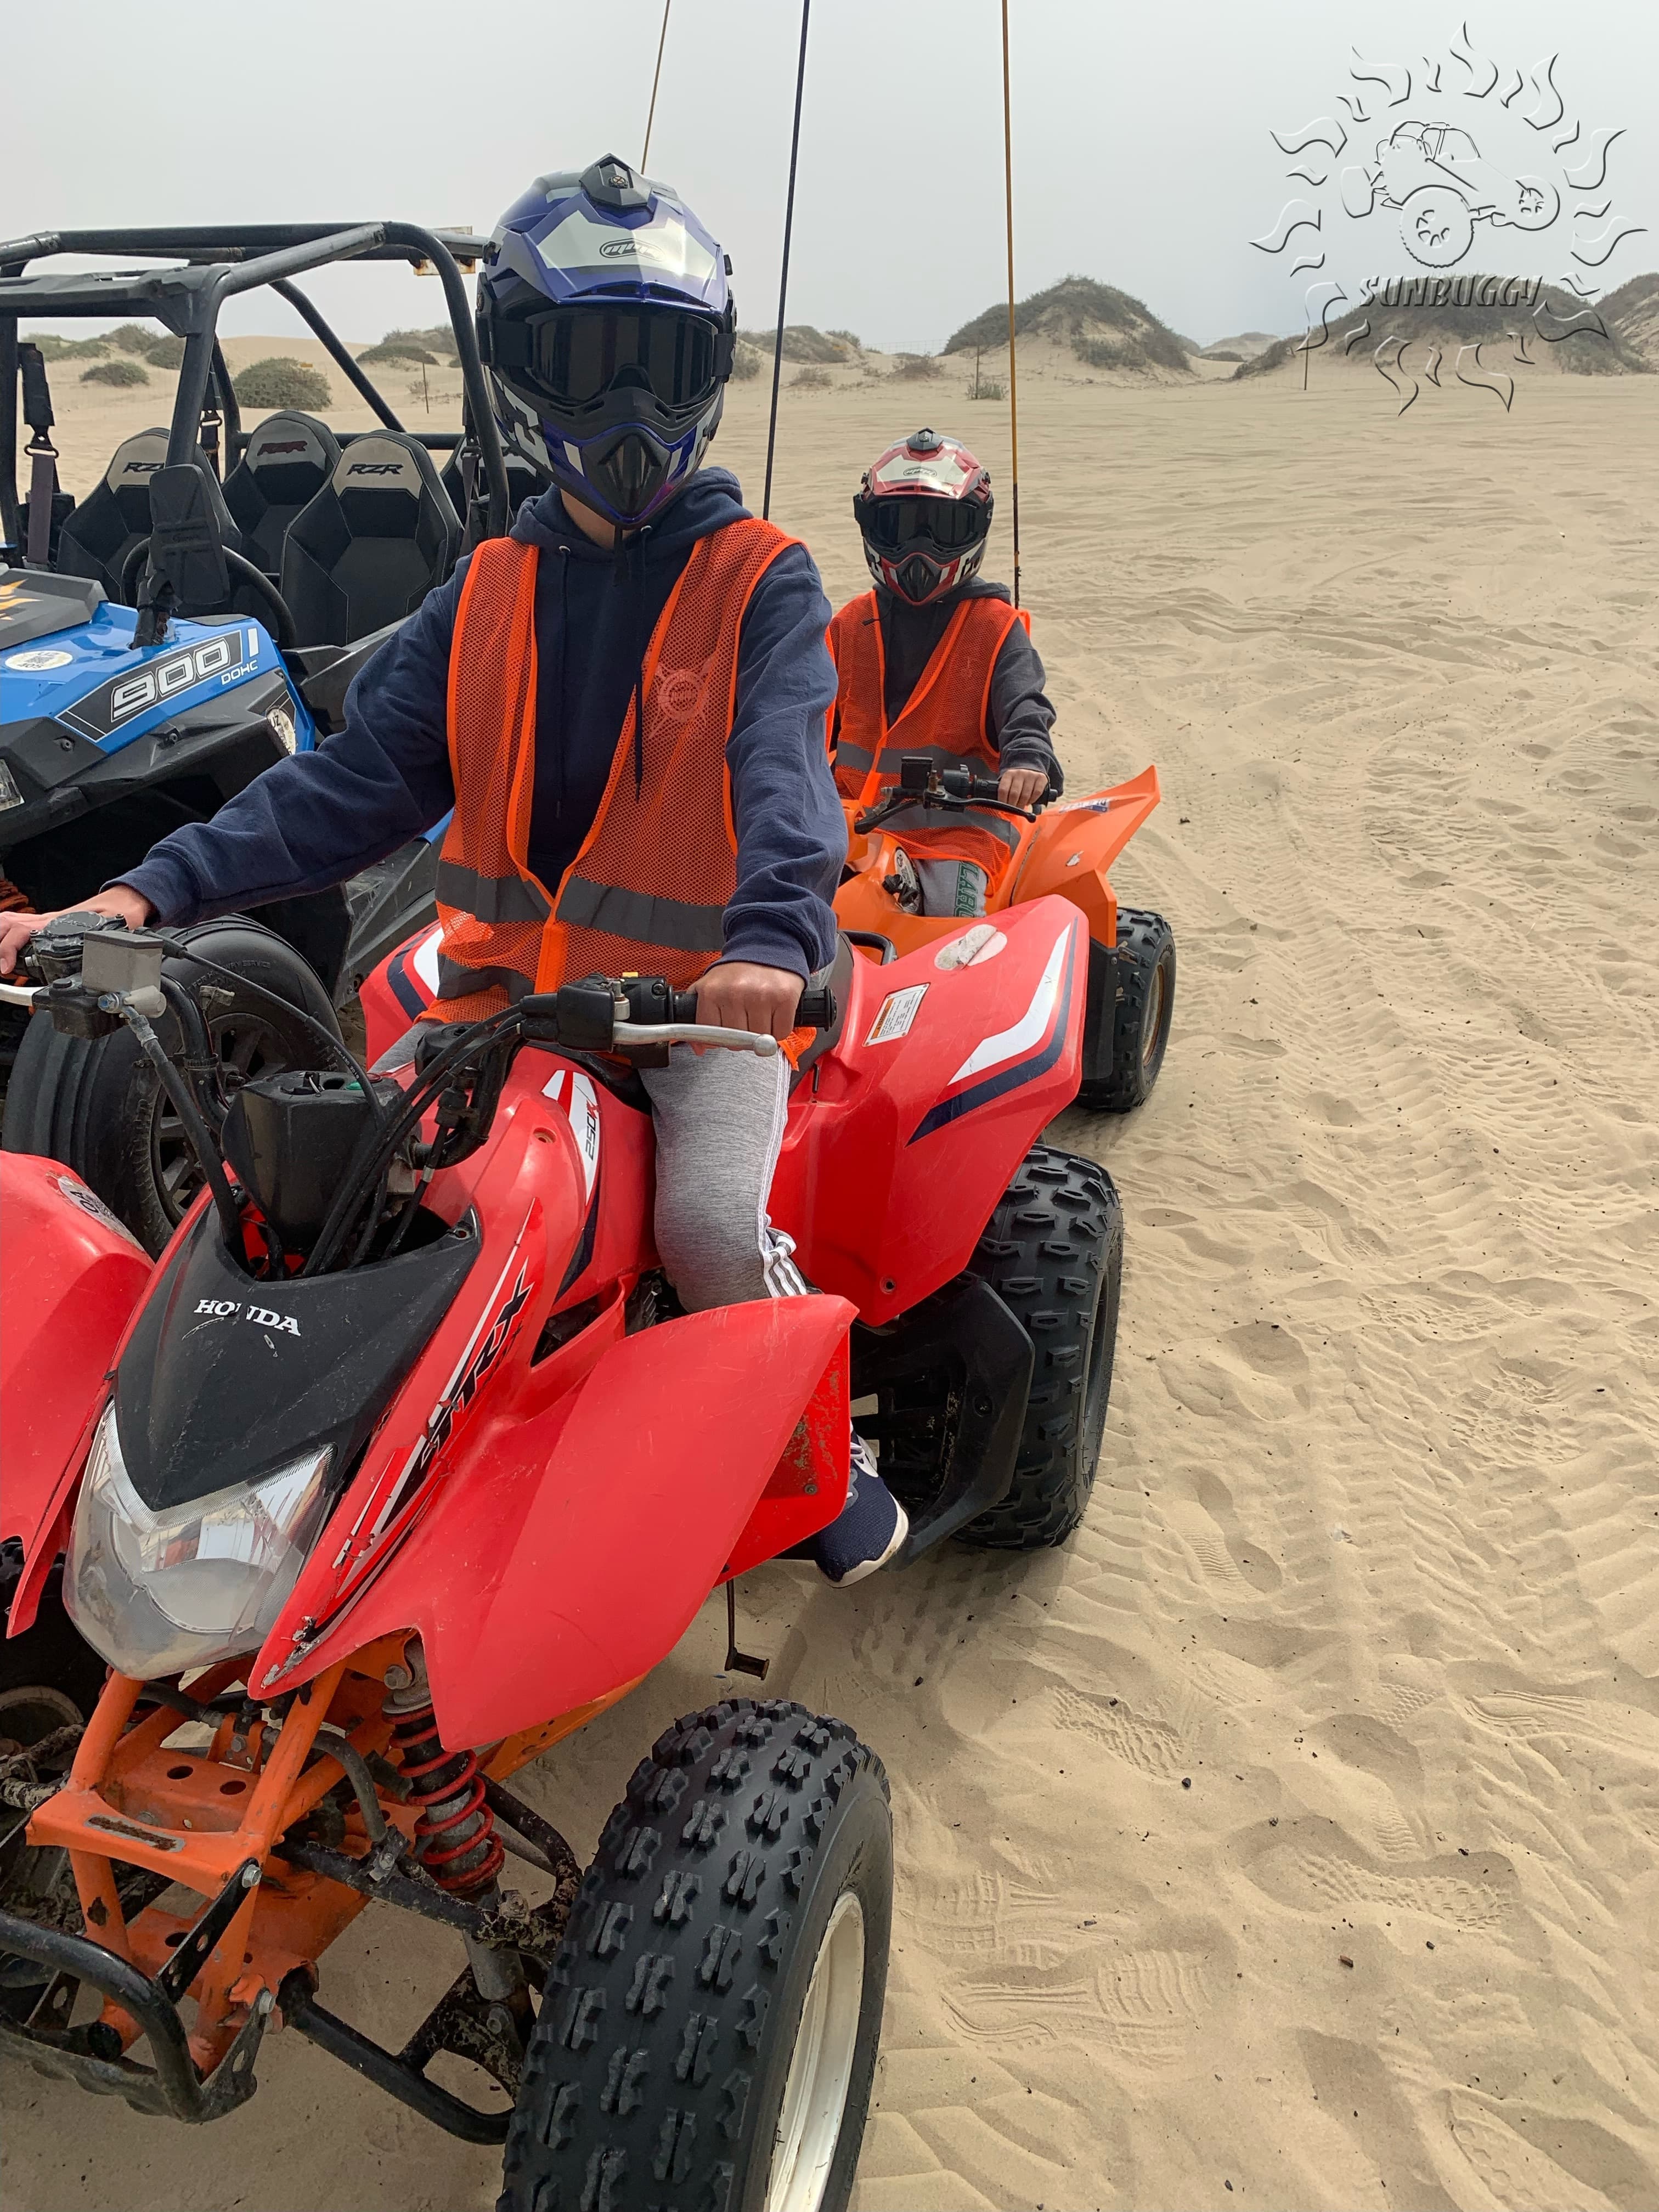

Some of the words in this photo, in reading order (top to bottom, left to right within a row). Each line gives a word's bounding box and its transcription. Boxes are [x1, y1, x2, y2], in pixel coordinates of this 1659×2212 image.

[257, 441, 309, 456] RZR
[346, 464, 404, 476] RZR
[111, 637, 231, 723] 900
[221, 659, 258, 685] DOHC
